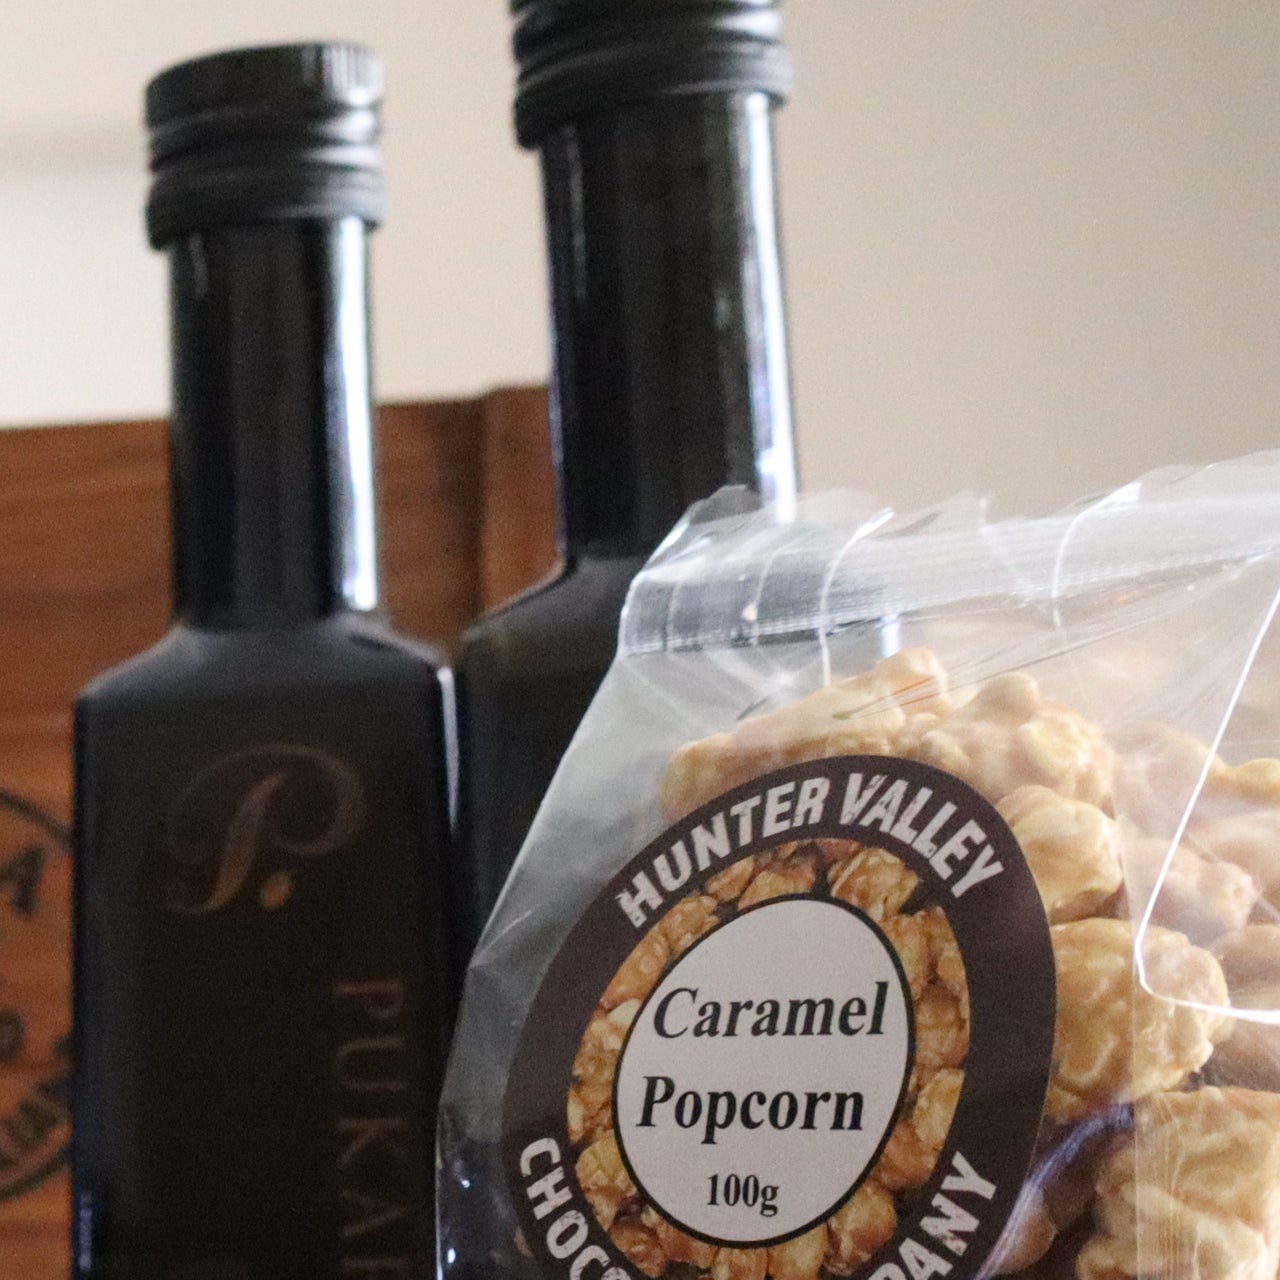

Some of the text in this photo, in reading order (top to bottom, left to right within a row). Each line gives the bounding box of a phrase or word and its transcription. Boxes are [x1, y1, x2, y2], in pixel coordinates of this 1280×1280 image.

[616, 772, 1005, 930] HUNTER VALLEY
[652, 981, 889, 1040] Caramel
[635, 1075, 865, 1144] Popcorn
[705, 1172, 780, 1217] 100g
